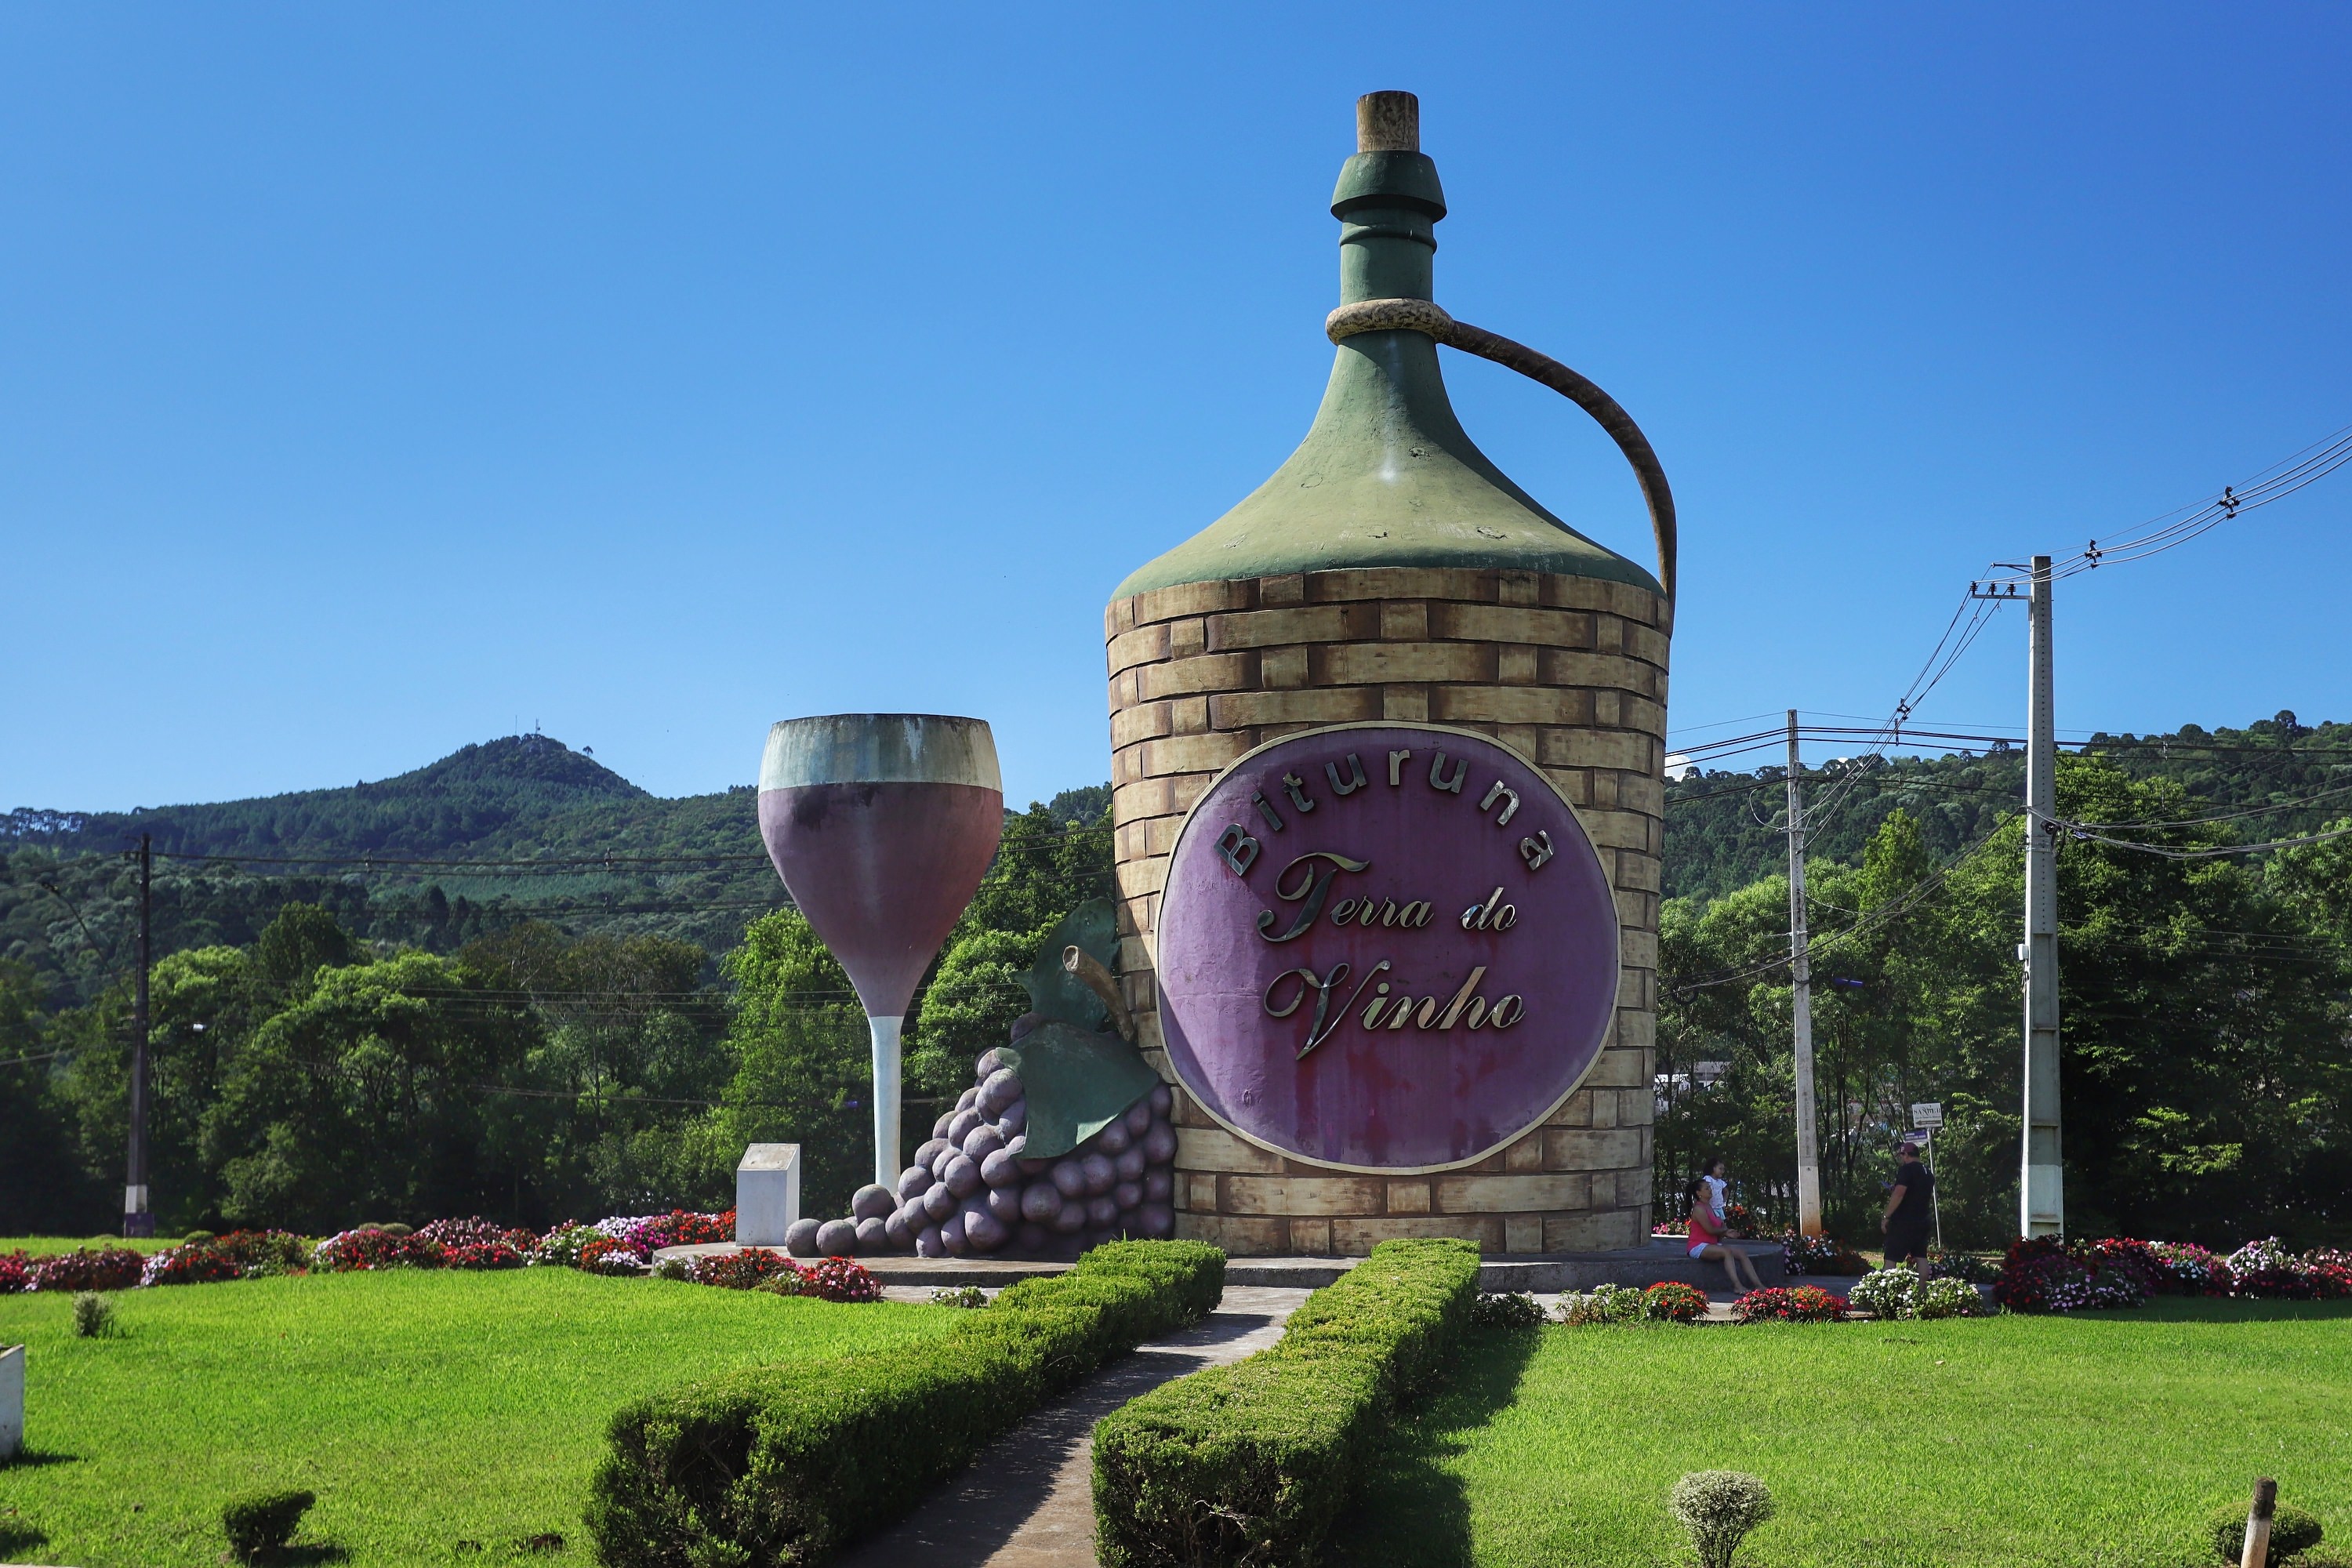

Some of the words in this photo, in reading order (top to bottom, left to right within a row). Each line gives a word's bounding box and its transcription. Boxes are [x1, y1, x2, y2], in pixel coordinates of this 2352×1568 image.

[1213, 750, 1555, 877] Bituruna
[1256, 851, 1434, 942] Terra
[1460, 887, 1517, 931] do
[1263, 960, 1526, 1060] Vinho
